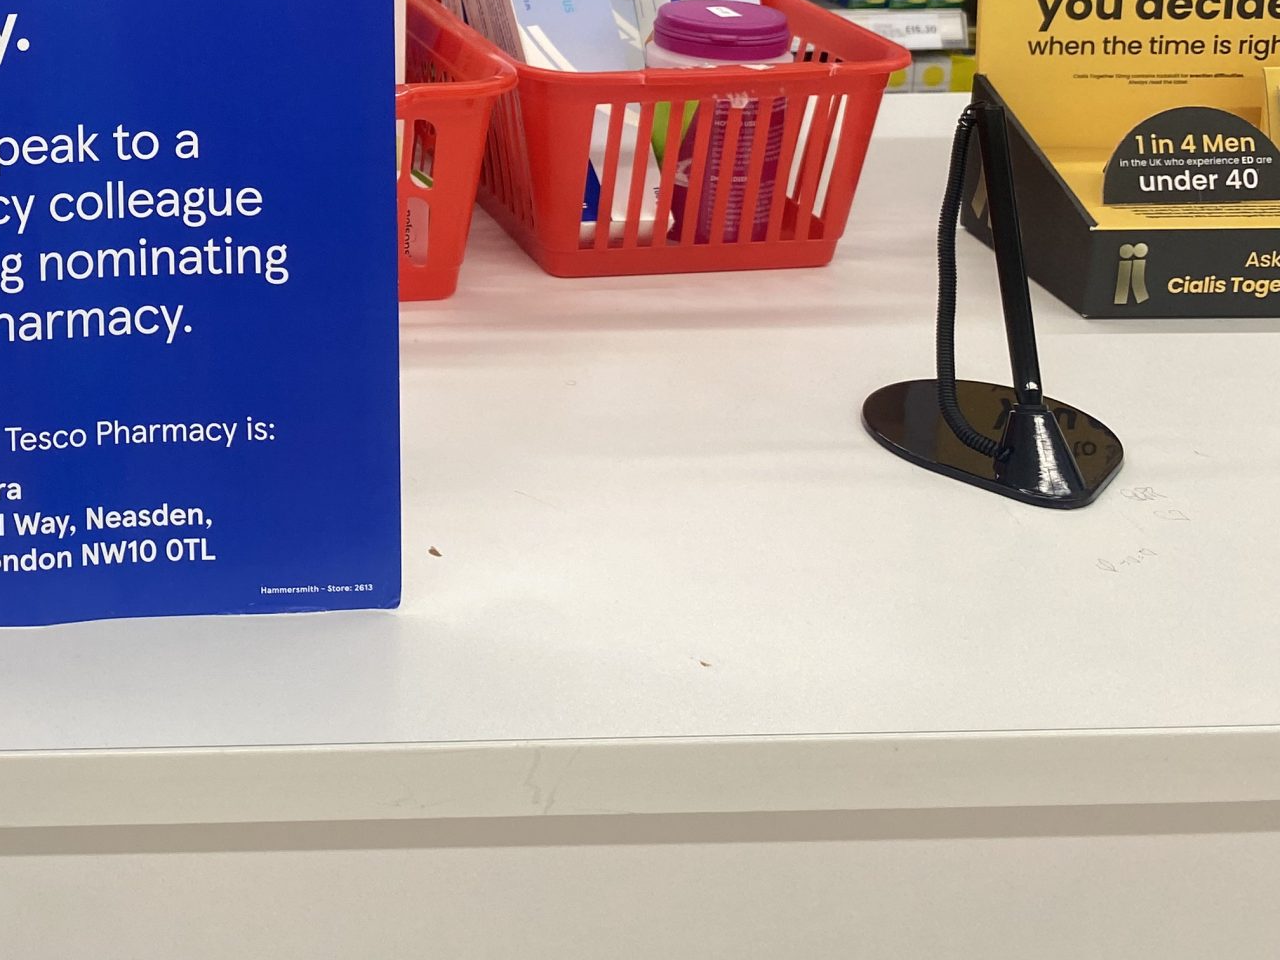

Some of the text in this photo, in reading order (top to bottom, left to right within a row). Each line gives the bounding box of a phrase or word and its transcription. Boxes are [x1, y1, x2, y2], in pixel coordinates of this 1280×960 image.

[1028, 36, 1095, 55] when
[1104, 36, 1142, 54] the
[1149, 35, 1205, 54] time
[1213, 35, 1231, 54] is
[112, 124, 160, 161] to
[175, 130, 199, 159] a
[1135, 134, 1255, 154] 1 in 4 Men
[1120, 158, 1129, 167] in
[1130, 158, 1147, 167] the
[1149, 158, 1162, 166] UK
[1164, 157, 1184, 166] who
[1186, 156, 1239, 167] experience
[1242, 156, 1253, 164] ED
[1139, 169, 1258, 192] under 40
[49, 180, 263, 228] colleague
[39, 236, 289, 285] nominating
[1245, 251, 1280, 268] Ask
[1168, 277, 1225, 294] Cialis
[4, 426, 87, 452] Tesco
[96, 419, 238, 448] Pharmacy
[246, 416, 275, 441] is:
[13, 511, 76, 539] Way,
[86, 502, 213, 531] Neasden,
[81, 539, 157, 567] NW10
[260, 583, 373, 594] Hammersmith Store: 2613
